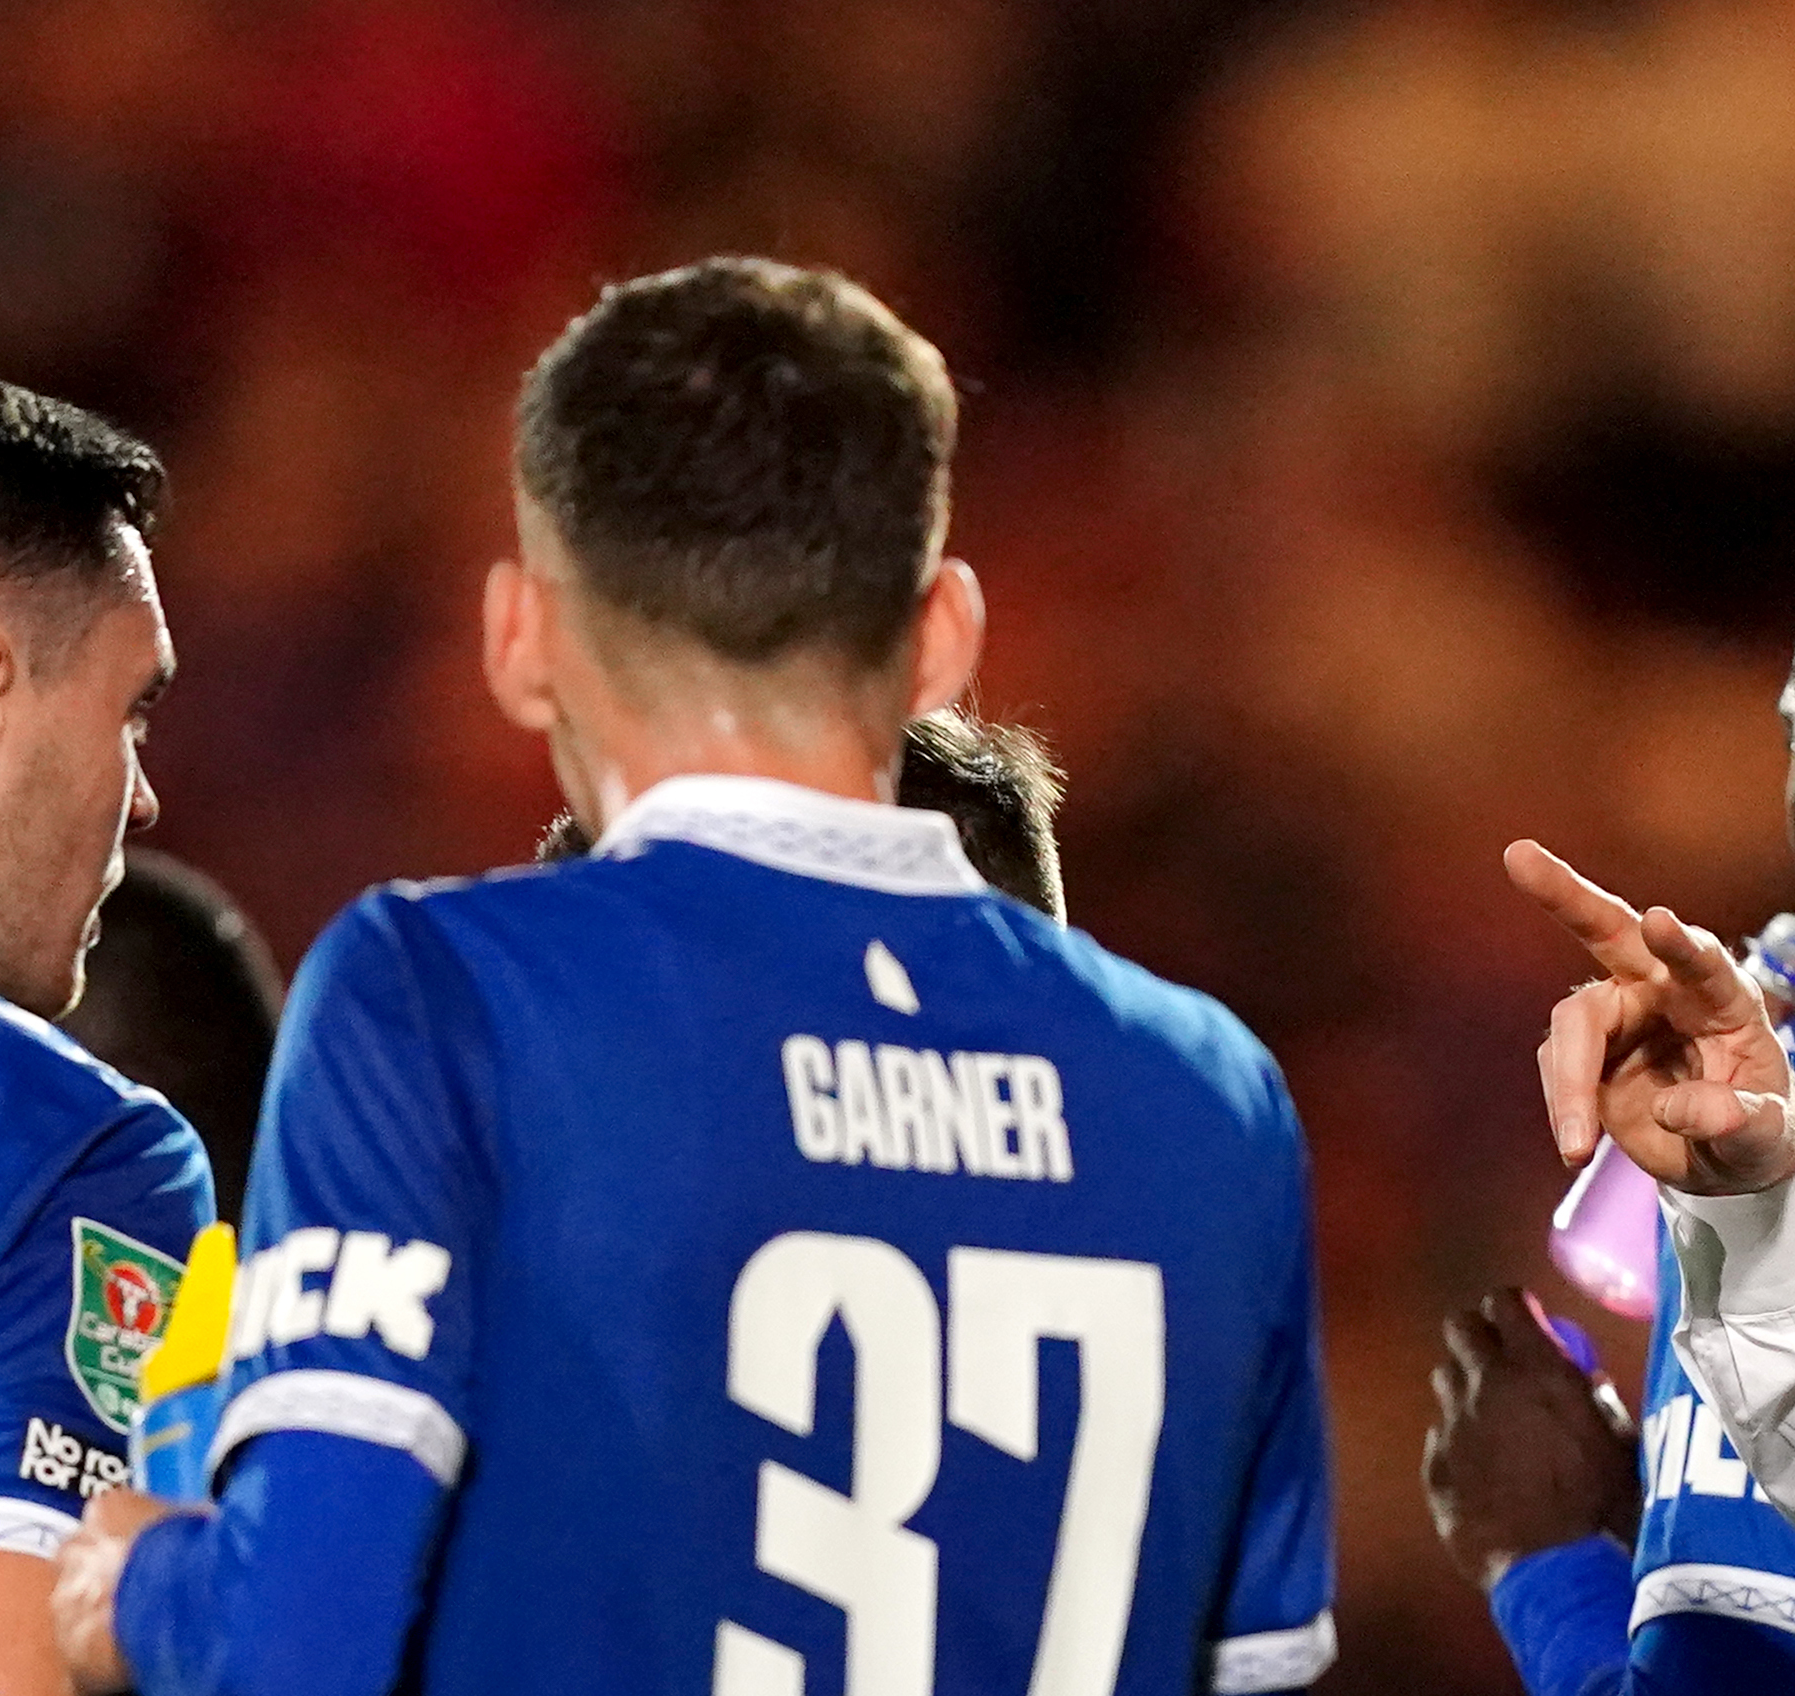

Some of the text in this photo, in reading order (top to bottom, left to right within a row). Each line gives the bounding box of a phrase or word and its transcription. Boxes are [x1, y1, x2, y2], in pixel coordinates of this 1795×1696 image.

[781, 1033, 1074, 1183] GARNER
[230, 1226, 452, 1361] ICK
[19, 1455, 79, 1490] for
[24, 1417, 83, 1467] No
